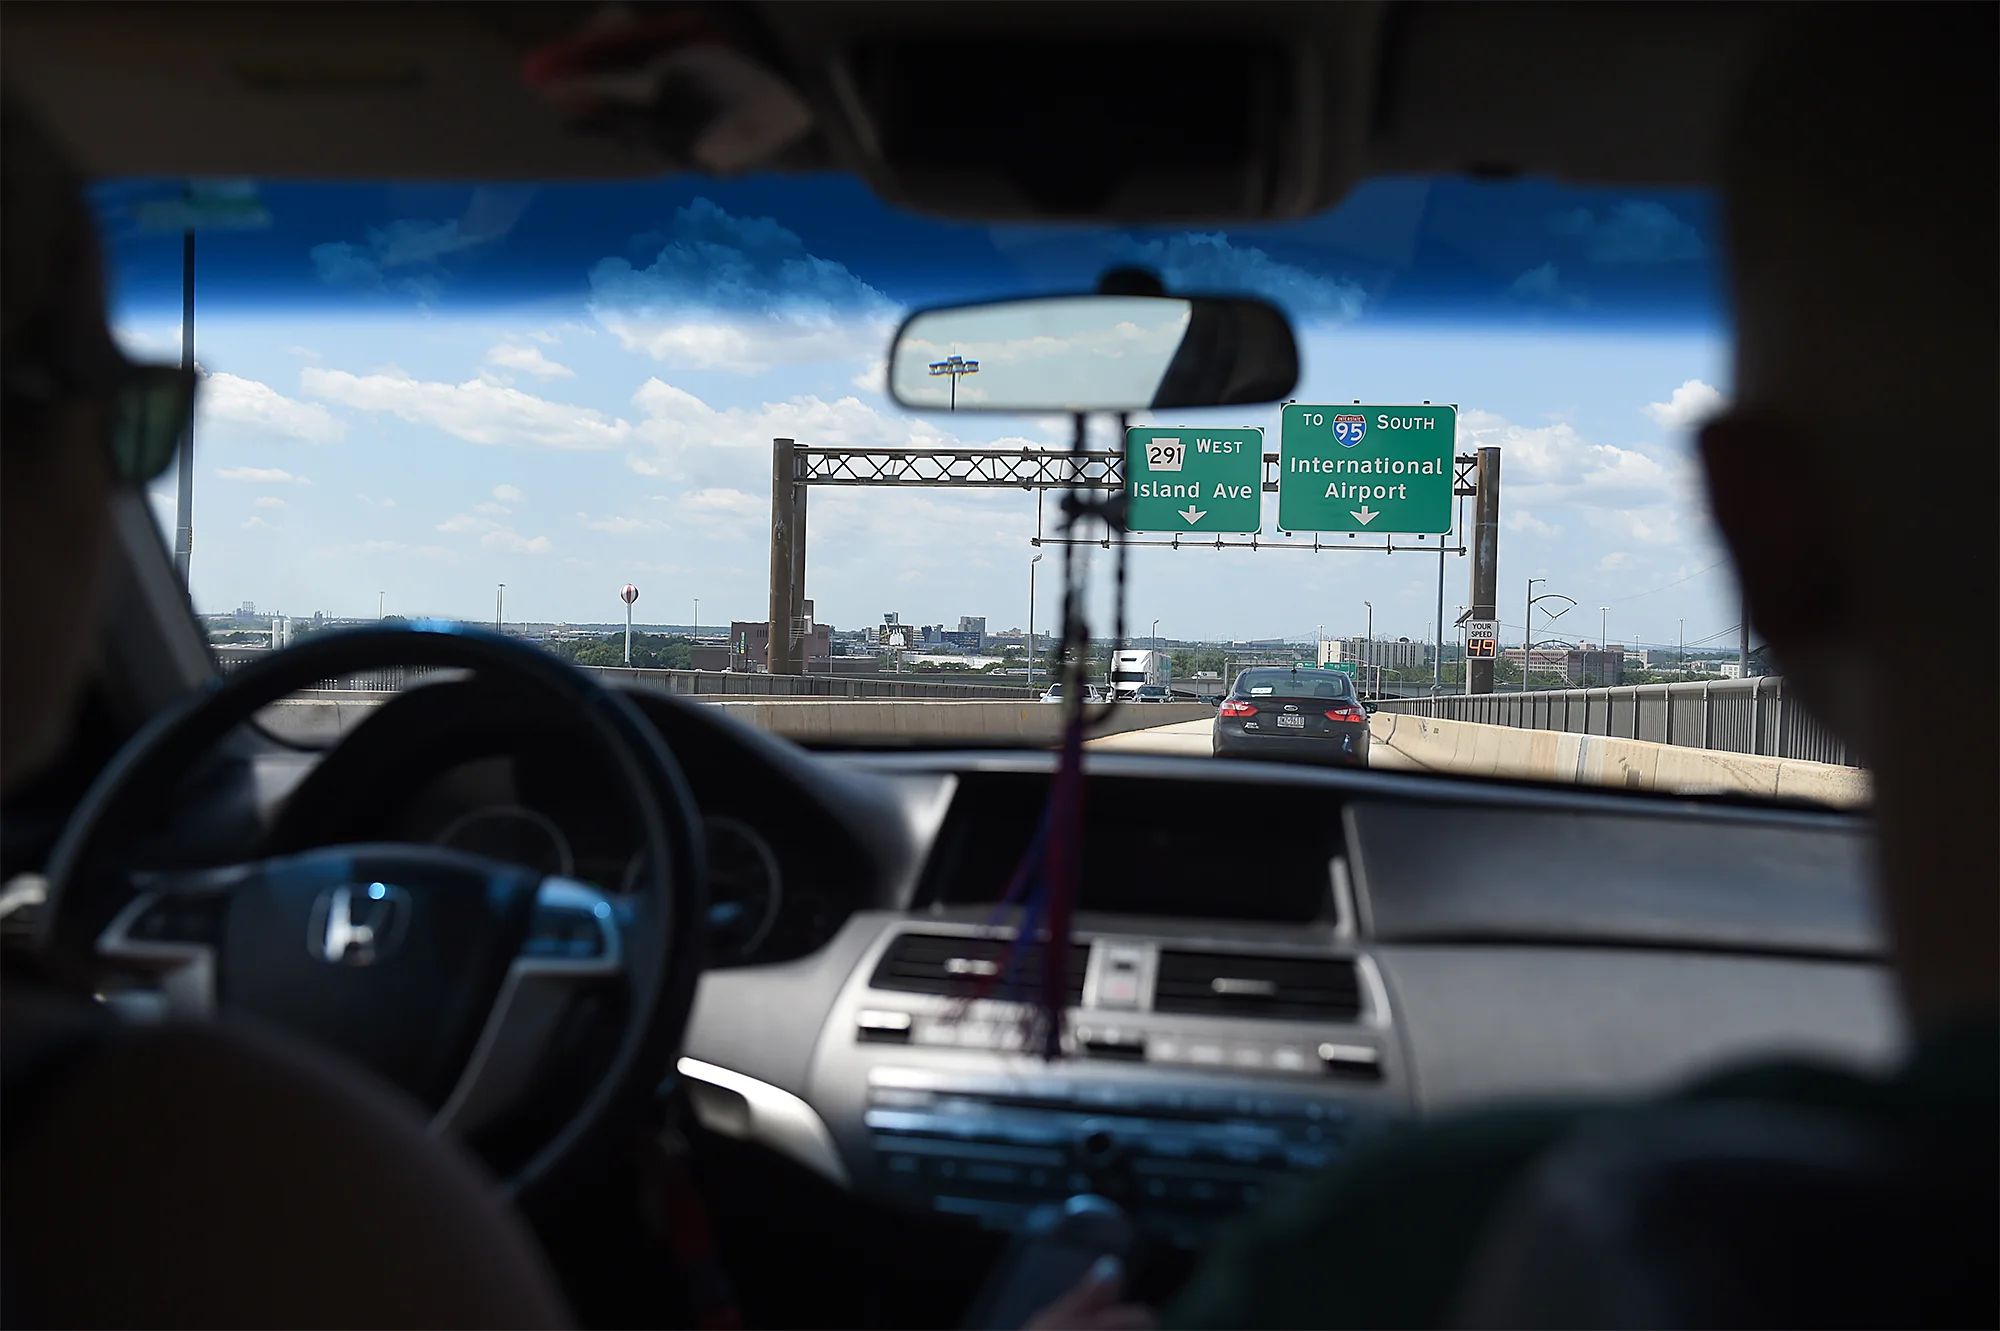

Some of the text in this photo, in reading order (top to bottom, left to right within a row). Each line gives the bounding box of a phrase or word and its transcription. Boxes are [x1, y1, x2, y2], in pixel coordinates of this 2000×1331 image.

[1303, 413, 1323, 426] TO
[1335, 422, 1363, 441] 95
[1149, 446, 1183, 465] 291
[1290, 457, 1443, 475] International
[1133, 481, 1253, 499] Island Ave
[1324, 482, 1406, 502] Airport
[1469, 639, 1494, 656] 49
